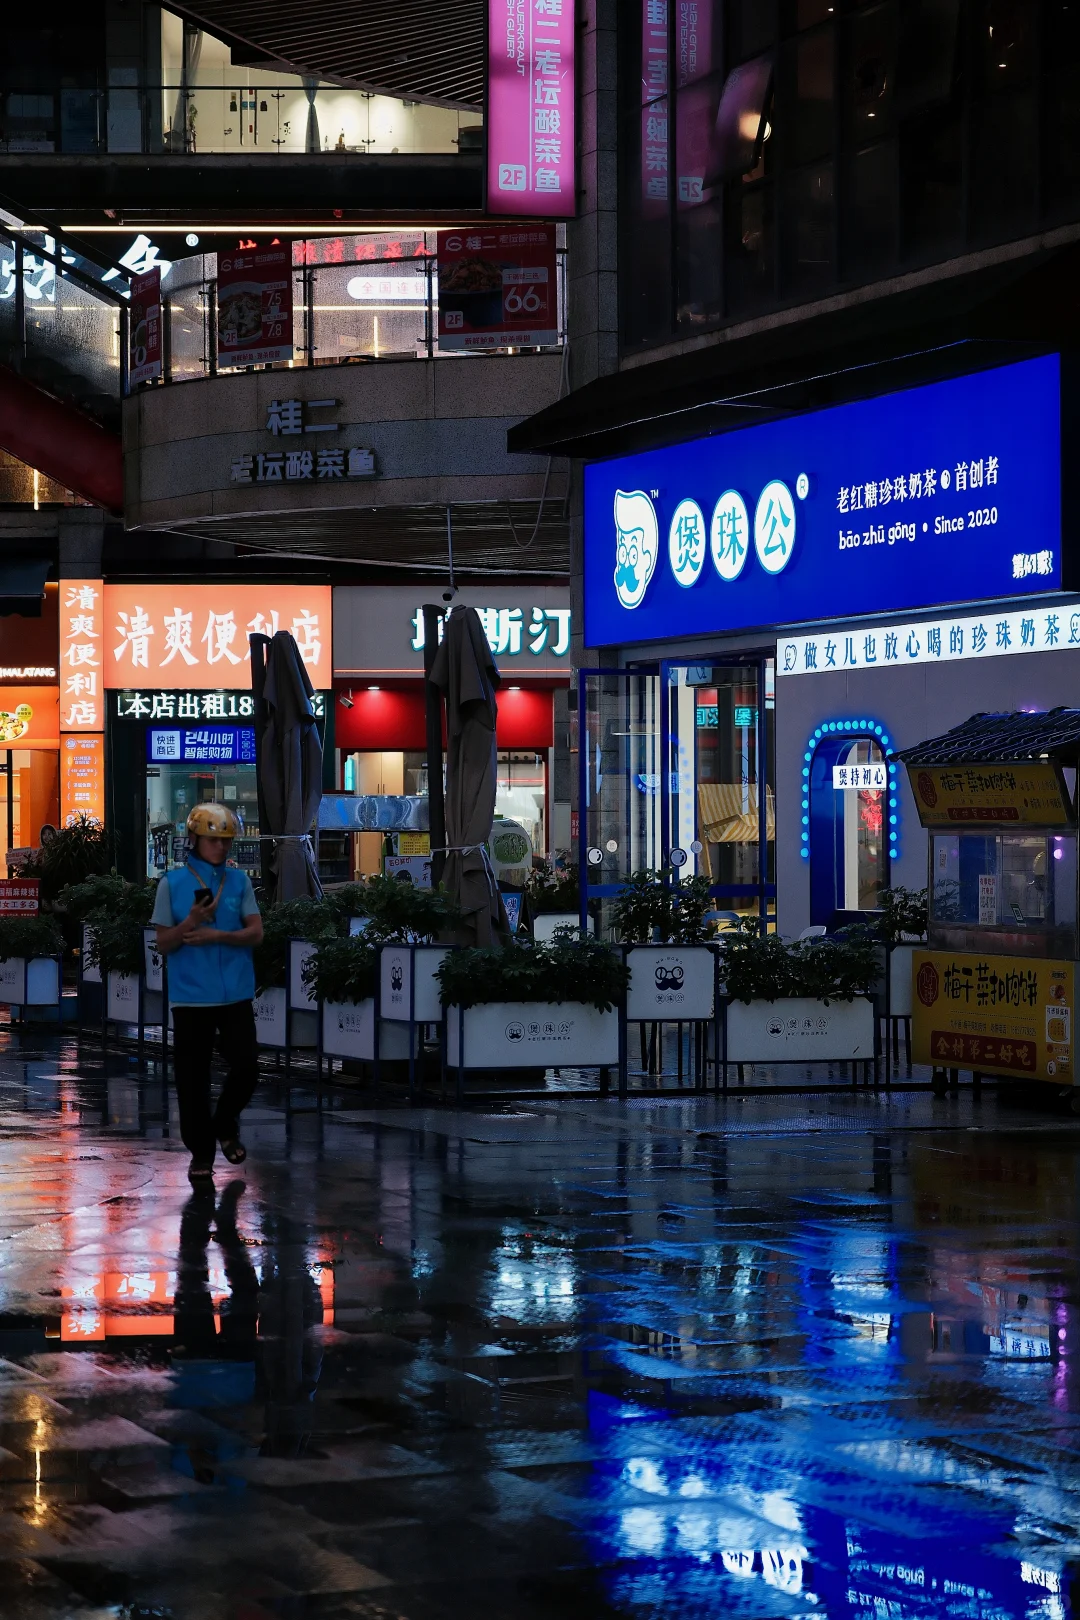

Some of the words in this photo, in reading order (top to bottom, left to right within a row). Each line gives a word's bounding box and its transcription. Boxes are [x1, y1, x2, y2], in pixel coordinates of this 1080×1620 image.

[507, 22, 515, 59] GUIER
[502, 170, 523, 185] 2F
[447, 314, 461, 325] 2F
[226, 333, 236, 343] 2F
[266, 399, 341, 436] 桂二
[230, 447, 376, 483] 老坛酸菜鱼
[836, 469, 938, 514] 老红糖珍珠奶茶
[954, 455, 1000, 492] 首创者
[675, 498, 791, 573] 煲珠公
[838, 531, 860, 550] bāo
[862, 525, 885, 545] zhū
[888, 522, 916, 545] gōng
[934, 515, 965, 535] Since
[967, 506, 999, 528] 2020
[65, 585, 99, 726] 清爽便利店
[804, 614, 1060, 670] 做女儿也放心喝的珍珠奶茶
[156, 746, 175, 756] 商店
[184, 747, 233, 759] 智能购物
[185, 731, 233, 745] 24小时
[839, 767, 884, 786] 煲持初心
[944, 962, 1038, 1007] 梅干菜扣肉饼
[936, 1036, 1031, 1066] 全村第二好吃
